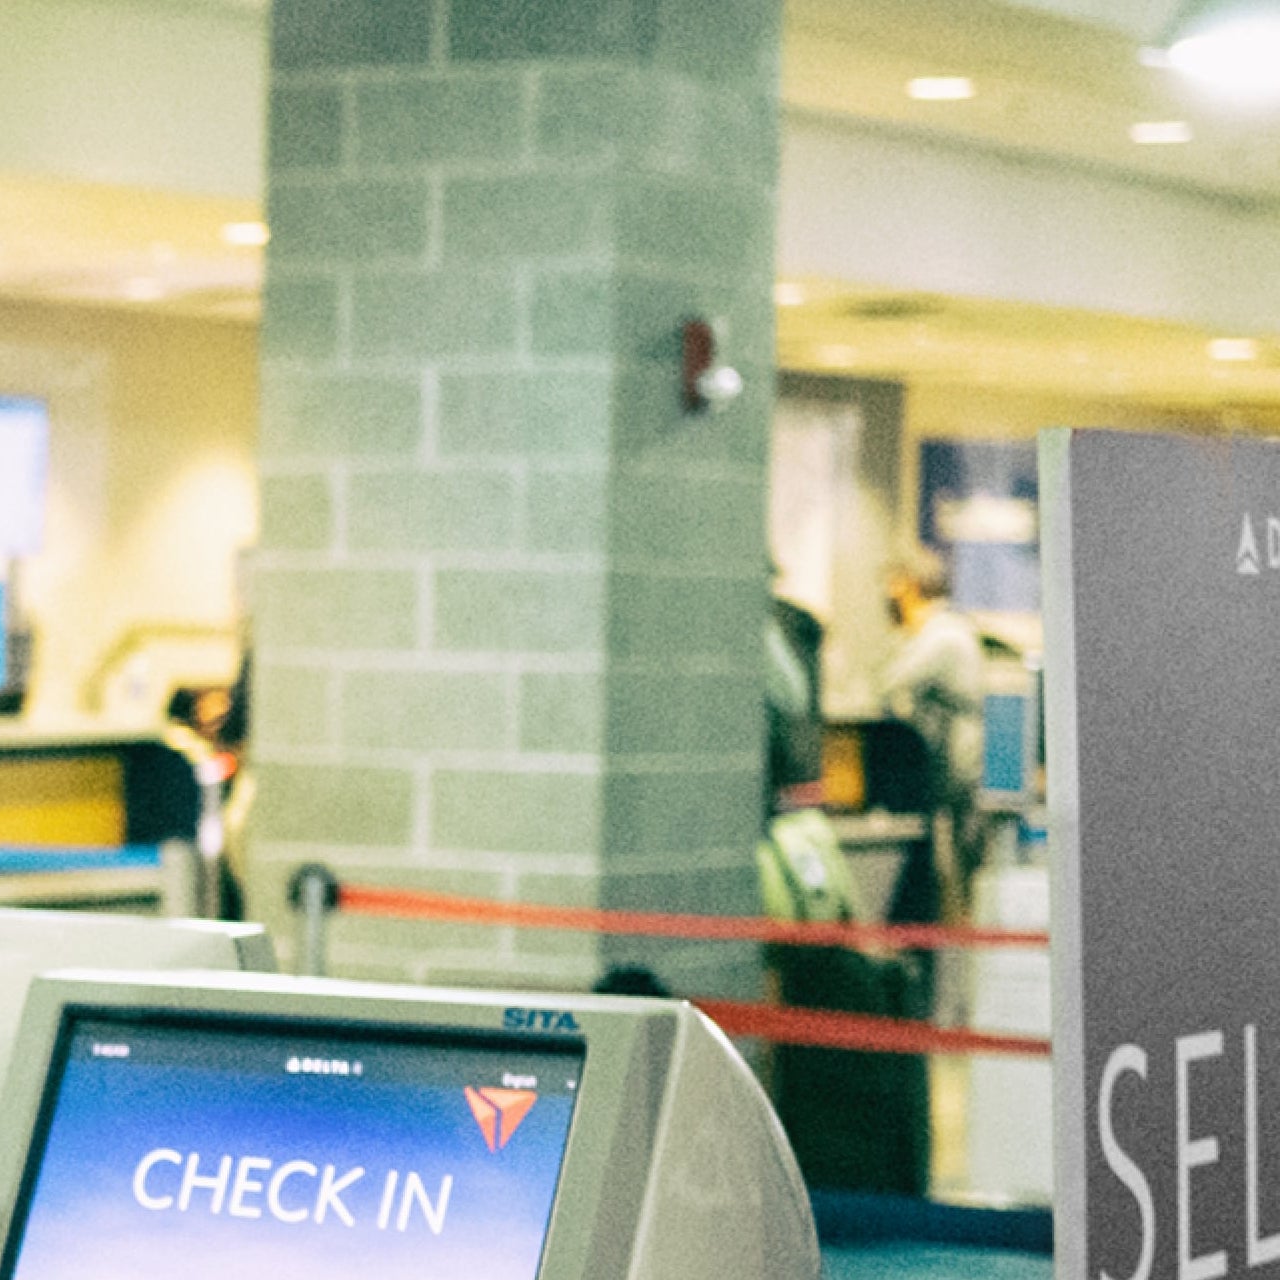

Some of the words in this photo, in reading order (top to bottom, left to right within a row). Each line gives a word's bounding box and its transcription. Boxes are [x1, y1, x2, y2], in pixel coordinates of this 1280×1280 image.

[503, 1007, 579, 1030] SITA
[132, 1148, 366, 1228] CHECK
[377, 1168, 454, 1236] IN
